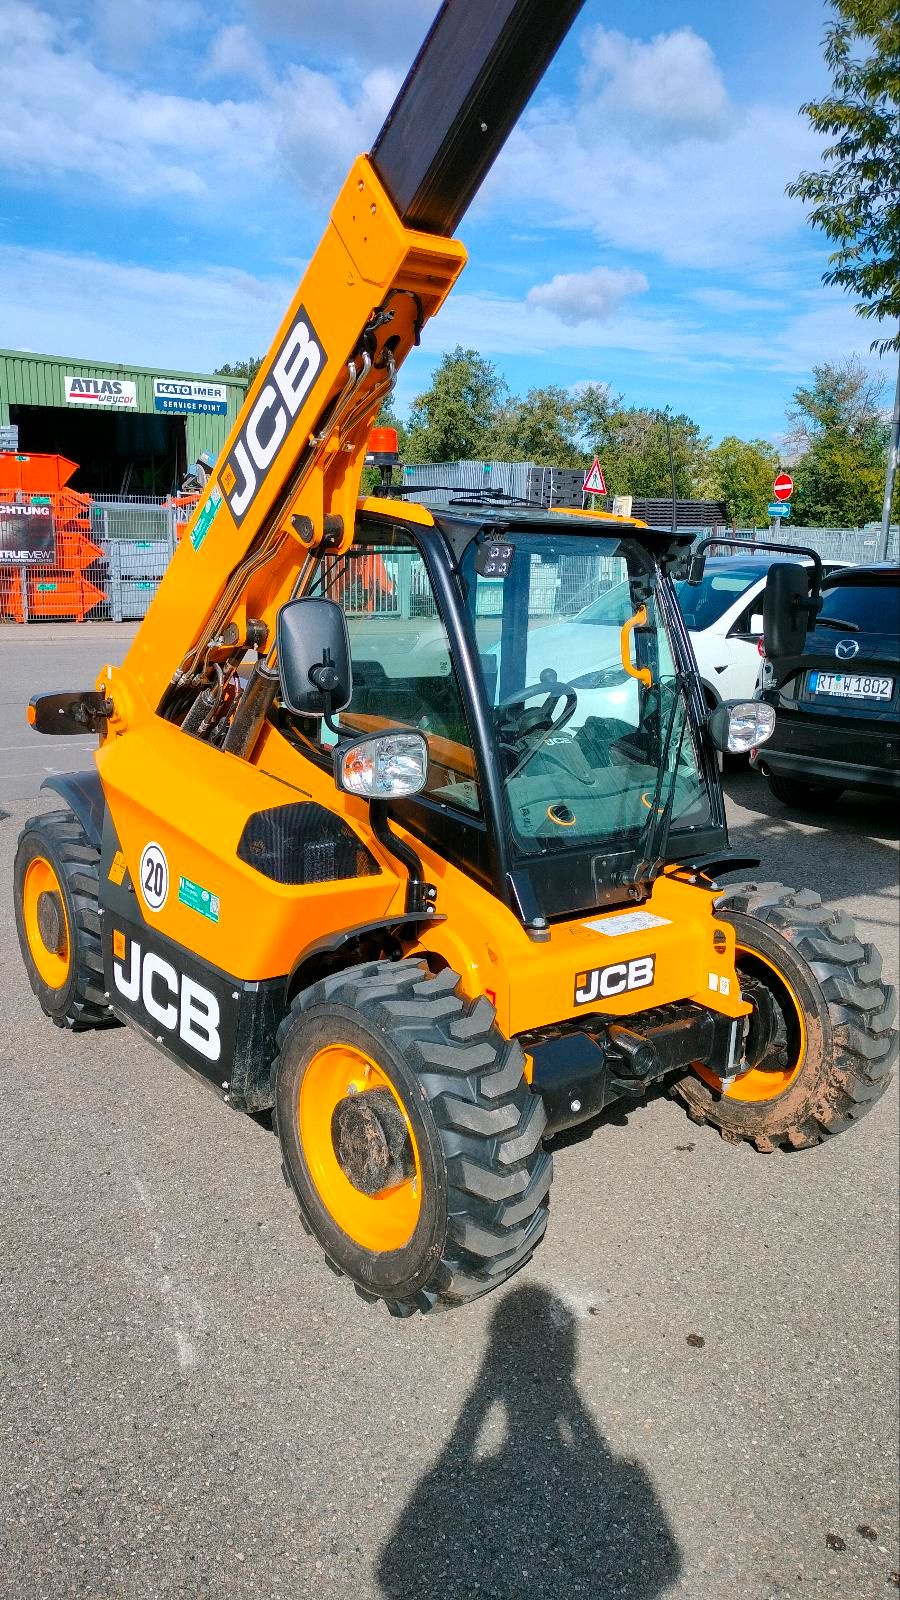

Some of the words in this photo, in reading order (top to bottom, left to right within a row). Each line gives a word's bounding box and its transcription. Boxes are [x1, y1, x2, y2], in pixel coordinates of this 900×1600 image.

[71, 378, 123, 395] ATLAS
[158, 384, 191, 395] KATO
[194, 387, 222, 397] IMER
[97, 394, 134, 405] weycor
[163, 400, 196, 410] SERVICE
[198, 404, 221, 412] POINT
[230, 321, 321, 516] JCB
[818, 674, 835, 690] RT
[843, 676, 852, 691] W
[854, 678, 889, 695] 1802
[144, 857, 164, 897] 20
[575, 957, 654, 1003] JCB
[113, 940, 221, 1061] JCB
